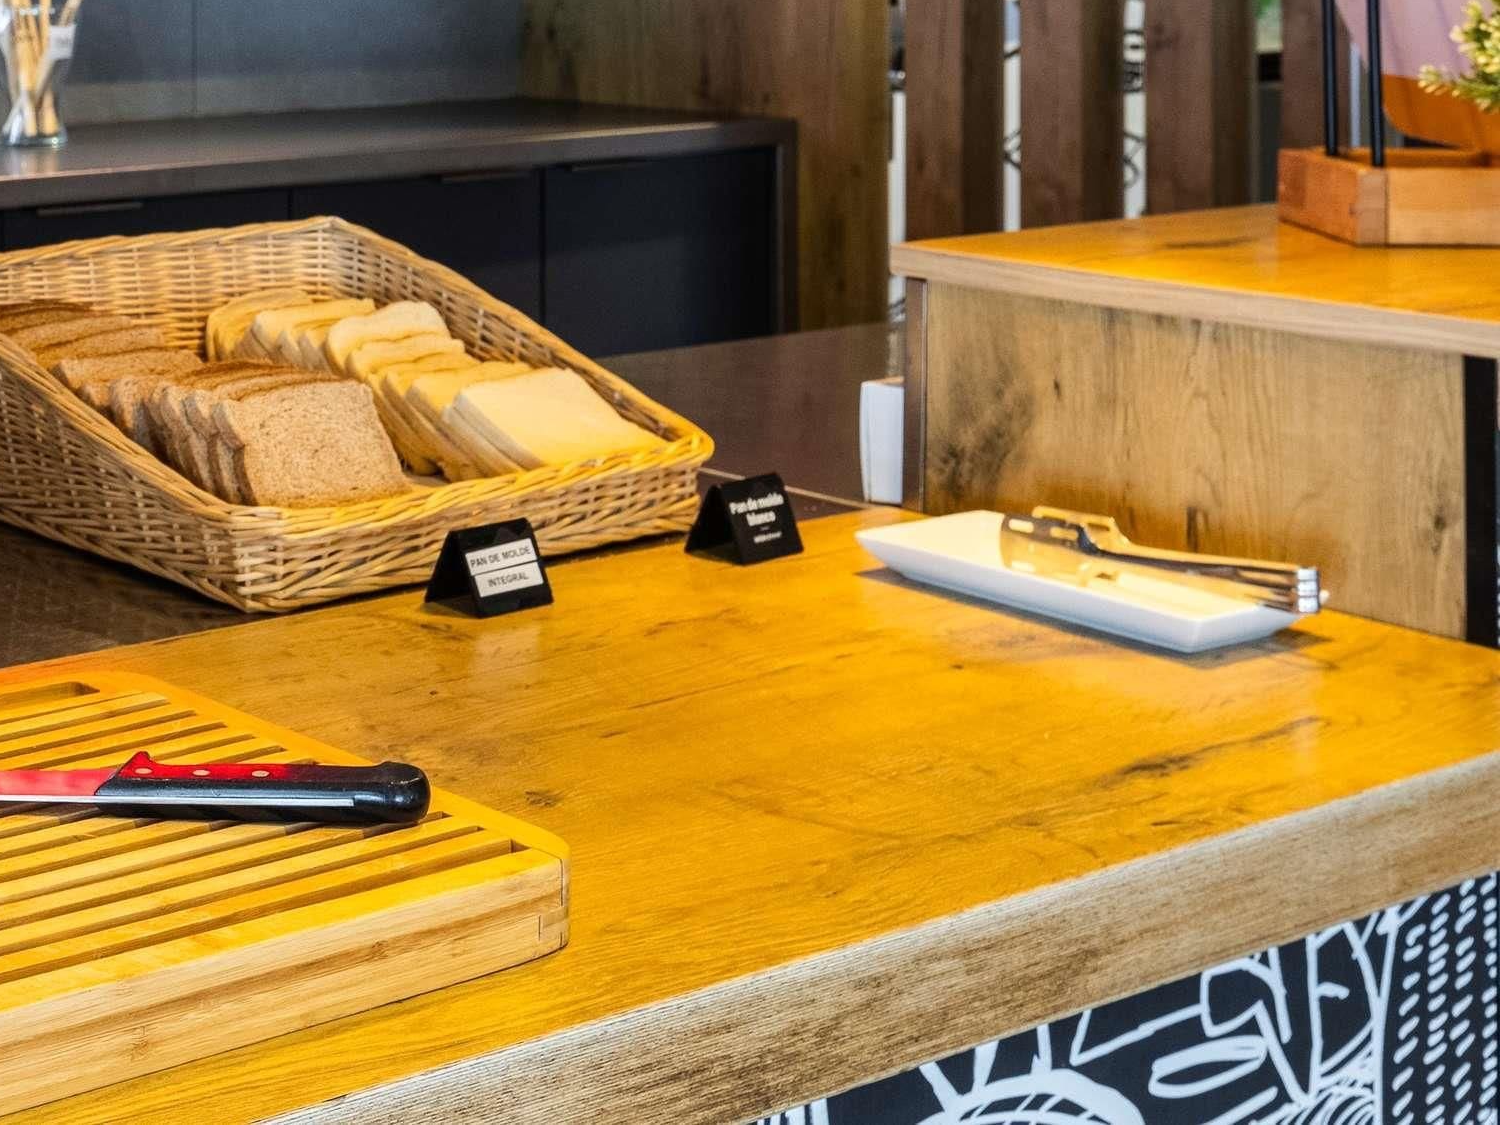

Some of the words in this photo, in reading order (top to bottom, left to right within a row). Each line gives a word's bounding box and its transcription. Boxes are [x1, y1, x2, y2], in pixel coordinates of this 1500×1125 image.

[470, 558, 488, 568] PAN
[489, 554, 501, 564] DE
[502, 546, 531, 560] MOLDE
[487, 572, 529, 588] INTEGRAL
